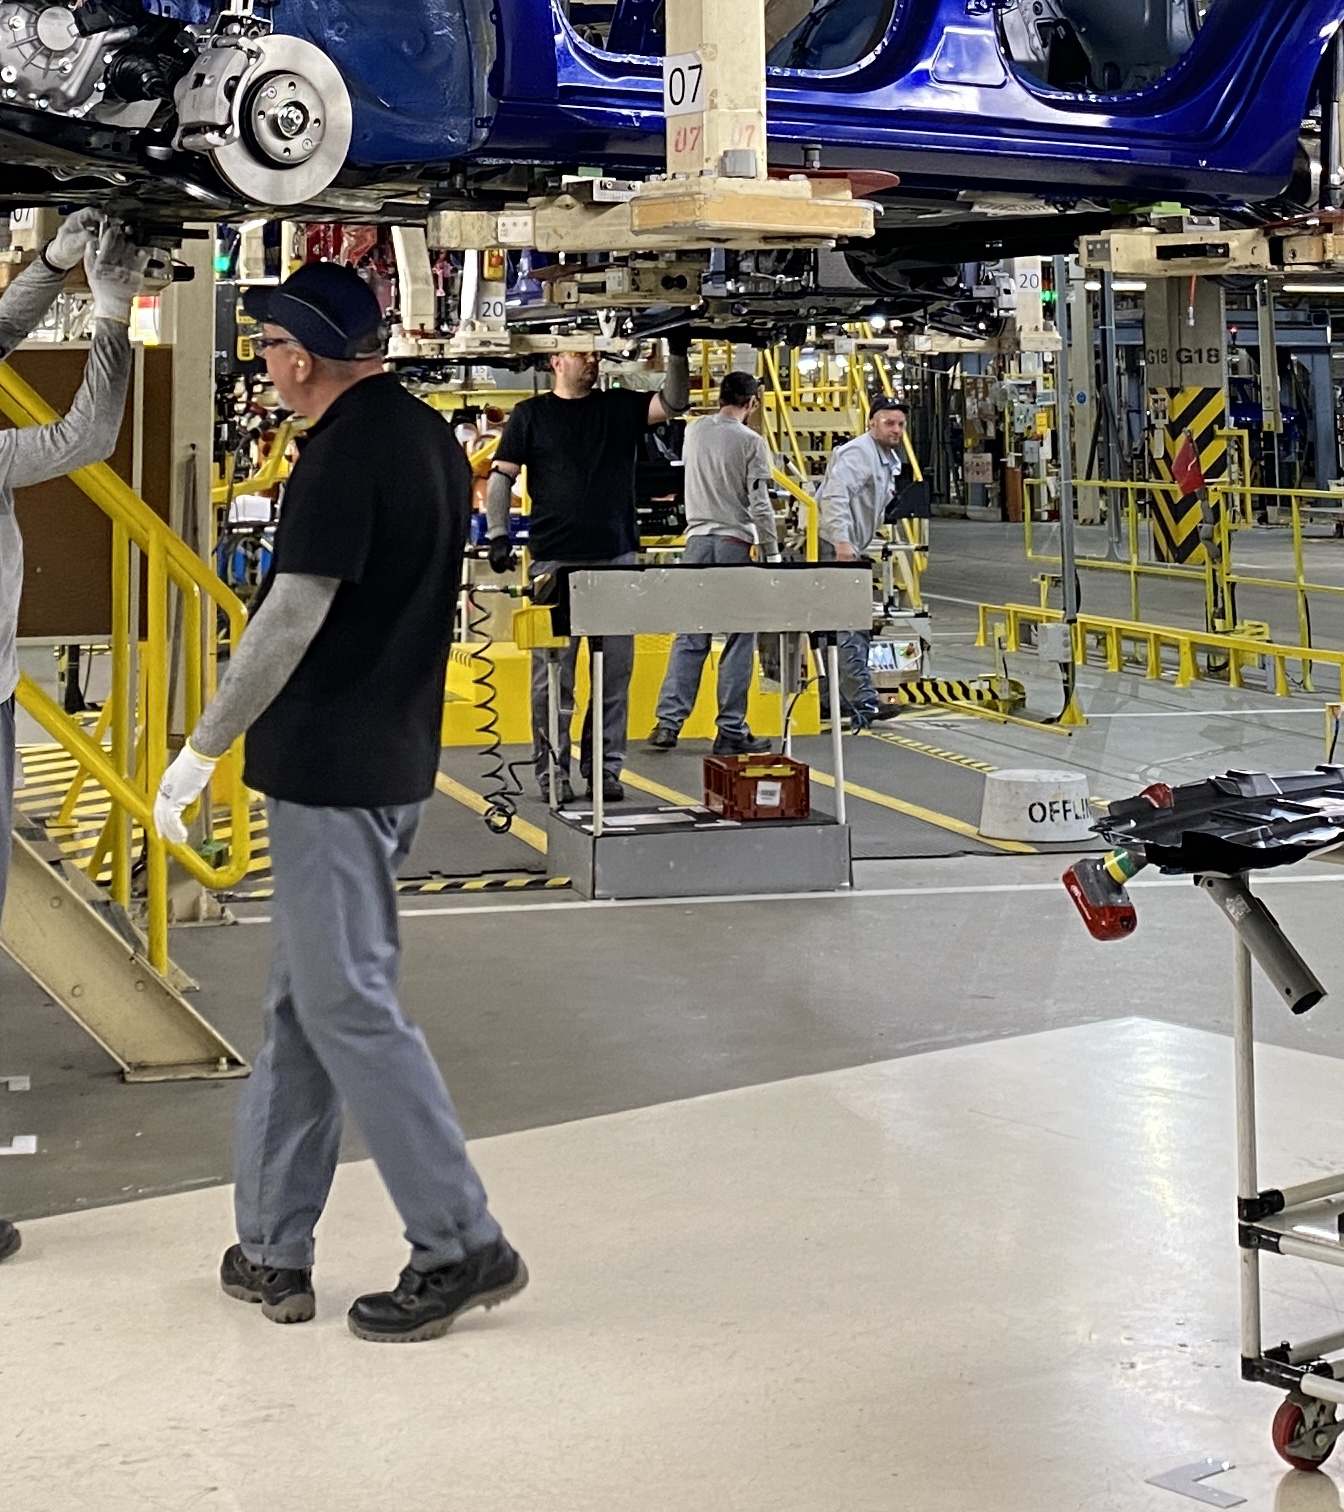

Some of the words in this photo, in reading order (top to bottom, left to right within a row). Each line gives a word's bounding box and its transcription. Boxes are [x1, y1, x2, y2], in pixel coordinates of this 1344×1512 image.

[669, 63, 703, 106] 07
[673, 125, 701, 153] 07
[1019, 273, 1040, 289] 20
[482, 301, 504, 318] 20
[1147, 348, 1168, 365] G18
[1175, 347, 1221, 364] G18
